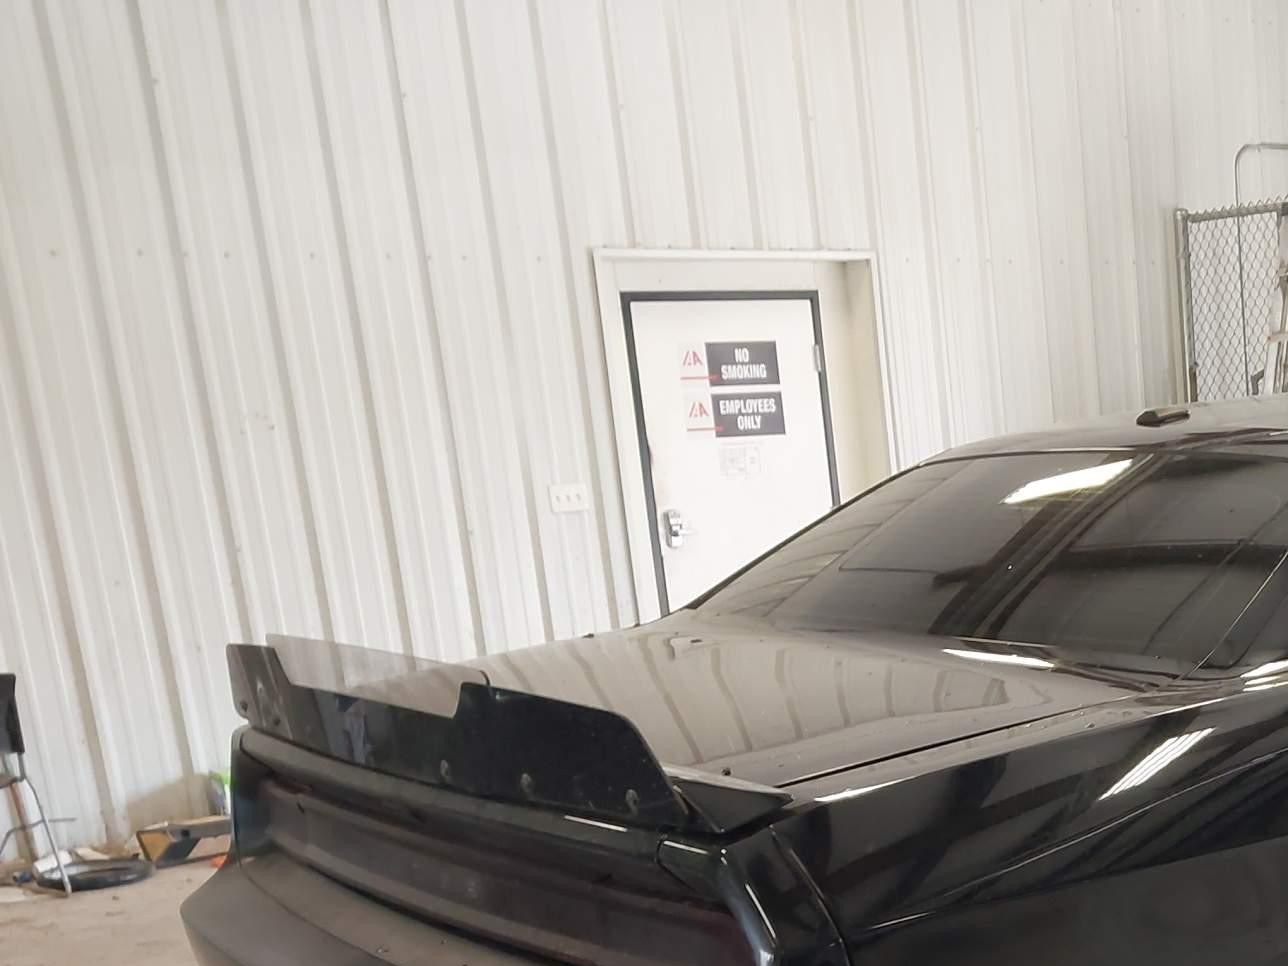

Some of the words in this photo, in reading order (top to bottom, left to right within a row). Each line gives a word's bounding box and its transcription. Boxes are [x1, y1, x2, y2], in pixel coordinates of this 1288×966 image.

[734, 347, 749, 363] NO
[720, 363, 767, 380] SMOKING
[719, 398, 776, 415] EMPLOYEES
[737, 415, 762, 430] ONLY
